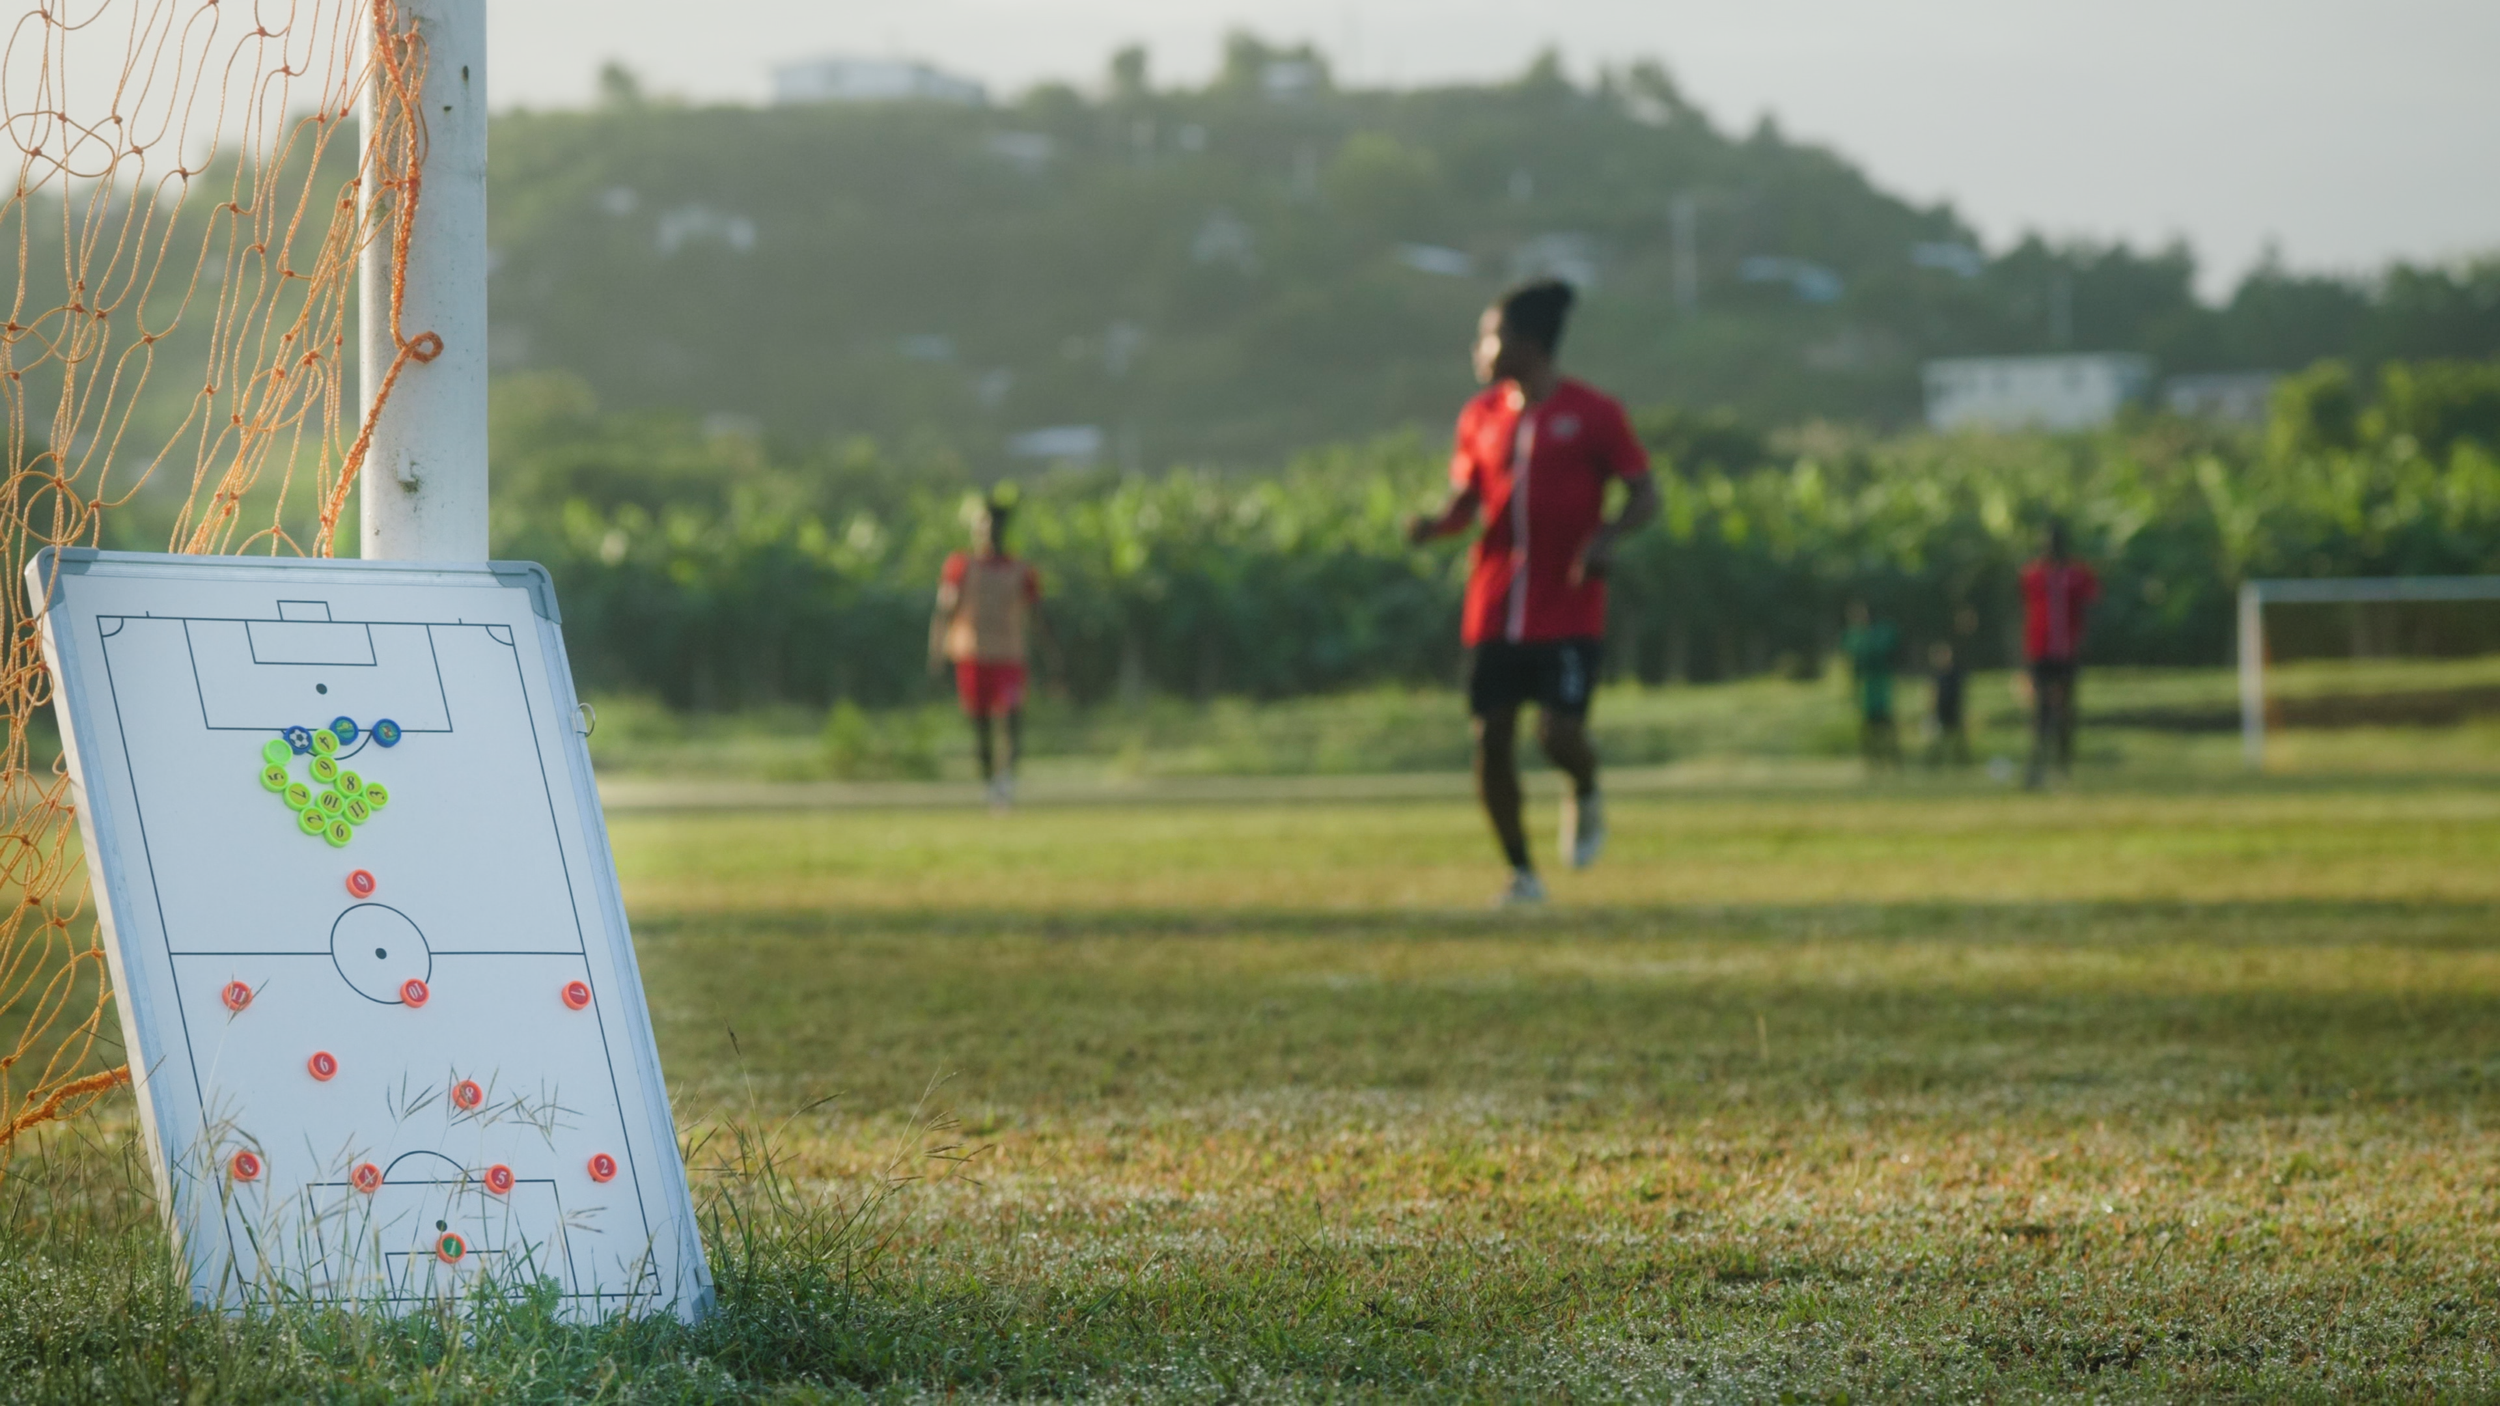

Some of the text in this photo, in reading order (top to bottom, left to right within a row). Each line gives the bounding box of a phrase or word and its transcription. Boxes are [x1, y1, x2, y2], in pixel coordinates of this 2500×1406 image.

[318, 736, 331, 750] 4
[268, 772, 284, 782] 5
[346, 776, 355, 791] 8
[291, 789, 307, 799] 7
[323, 794, 339, 809] 10
[369, 790, 385, 800] 3
[350, 801, 365, 818] 11
[307, 814, 323, 824] 2
[231, 987, 246, 1003] 11
[408, 983, 424, 999] 10
[571, 989, 586, 997] 7
[320, 1057, 329, 1072] 6
[600, 1158, 609, 1174] 2
[364, 1169, 374, 1184] 4
[496, 1171, 507, 1185] 5
[449, 1240, 457, 1255] 1
